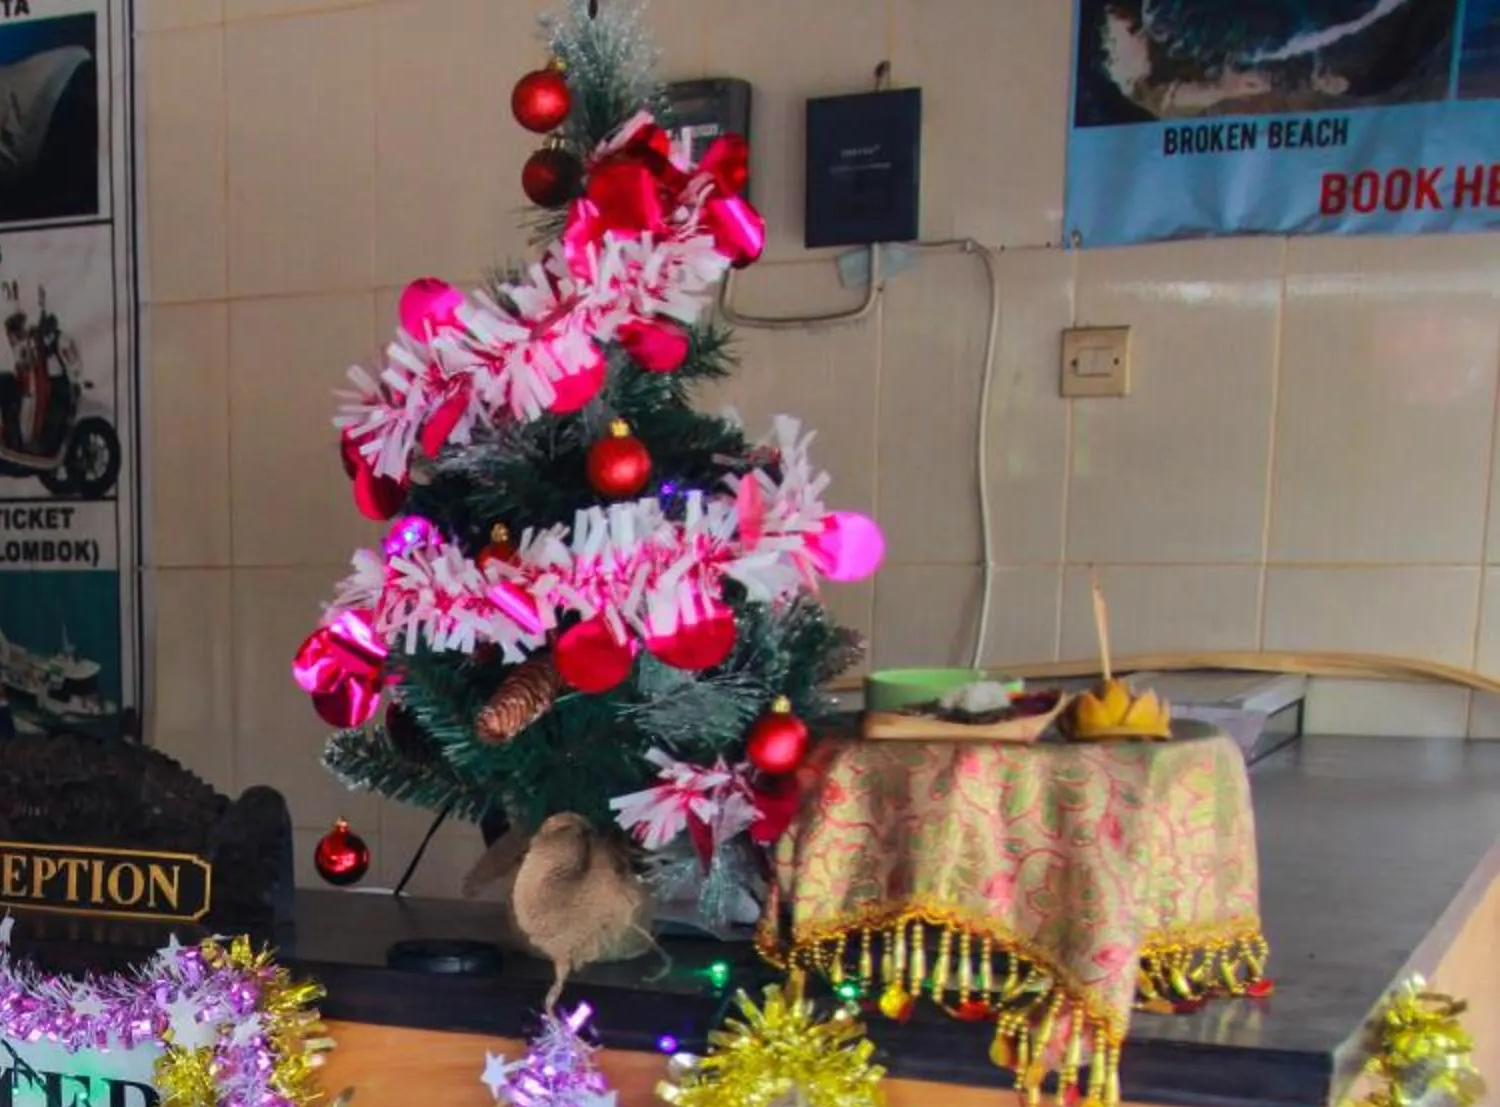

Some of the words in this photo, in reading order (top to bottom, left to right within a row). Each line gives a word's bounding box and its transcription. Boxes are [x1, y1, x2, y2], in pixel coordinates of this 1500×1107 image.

[1163, 122, 1257, 155] BROKEN
[1267, 118, 1348, 151] BEACH
[1320, 168, 1443, 215] BOOK
